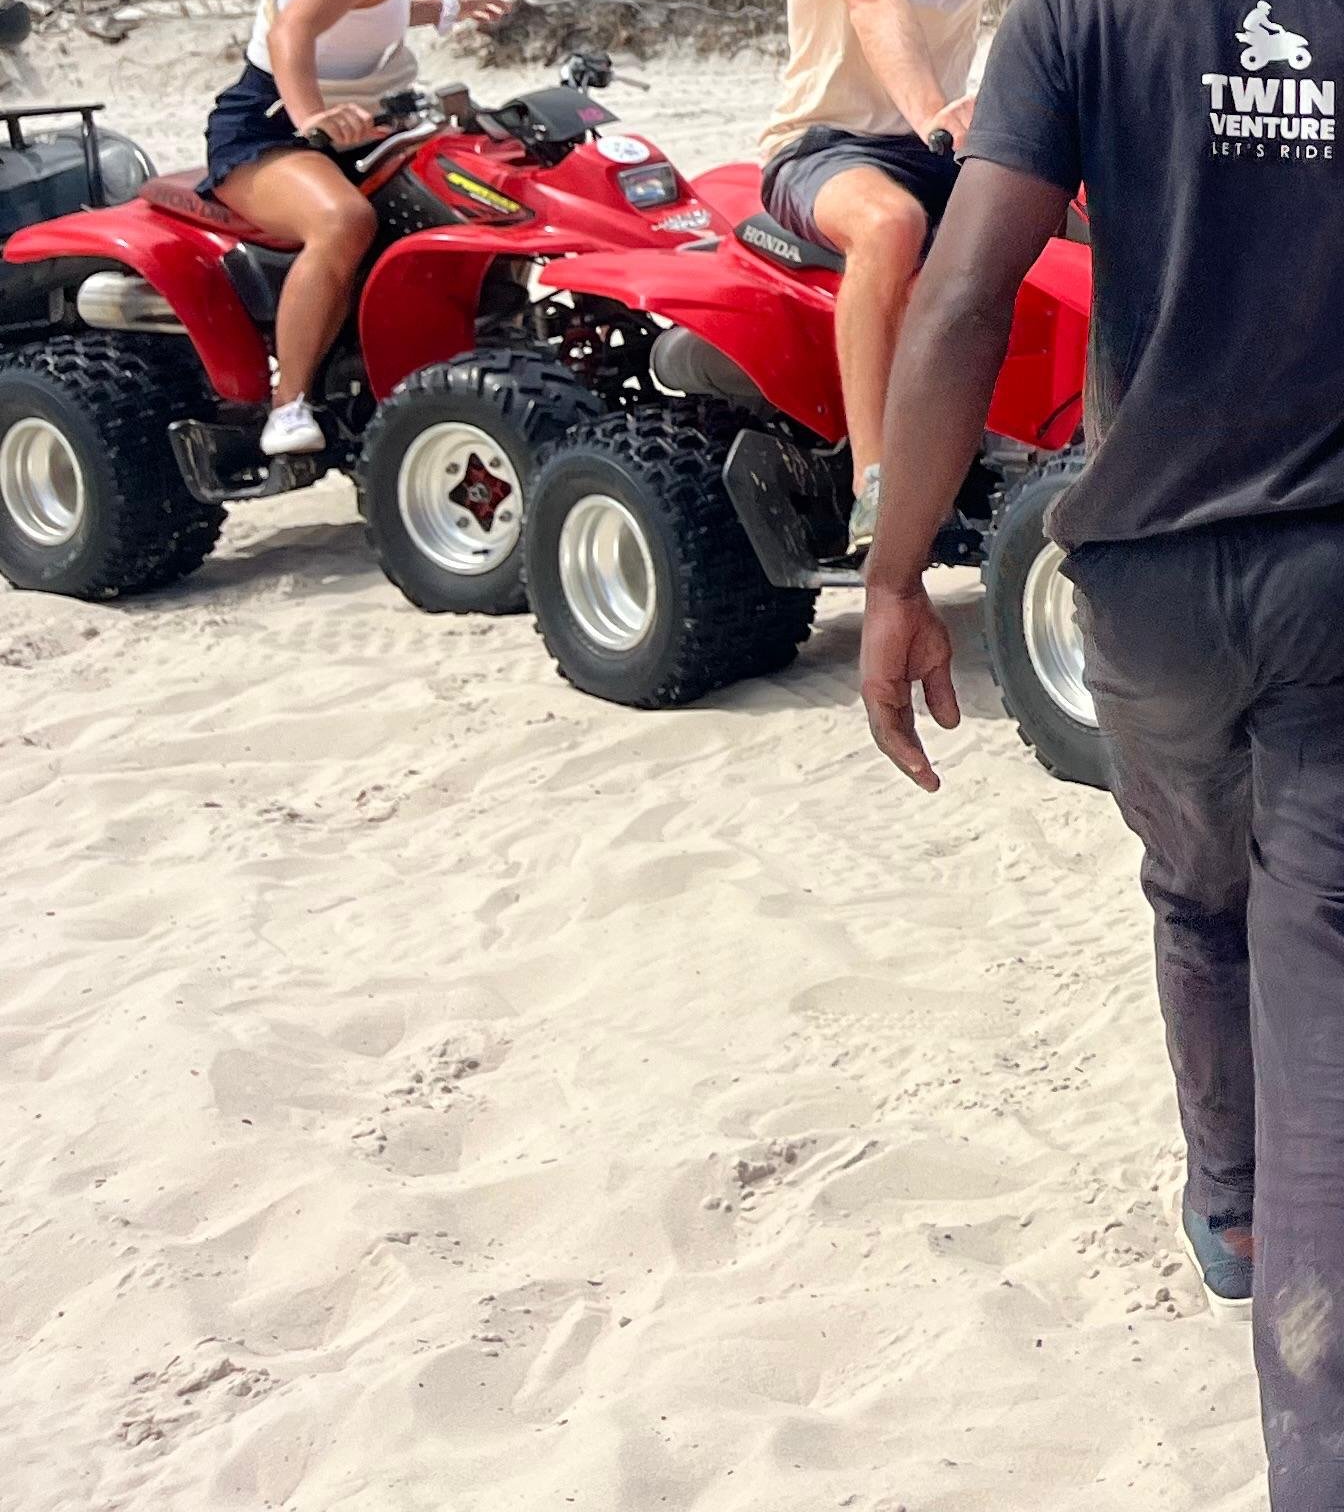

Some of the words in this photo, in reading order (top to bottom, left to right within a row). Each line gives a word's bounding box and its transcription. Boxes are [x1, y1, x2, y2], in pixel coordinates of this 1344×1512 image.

[1201, 72, 1336, 116] TWIN
[1208, 112, 1336, 141] VENTURE
[1212, 141, 1265, 159] LET'S
[1280, 144, 1333, 160] RIDE
[742, 224, 802, 263] HONDA
